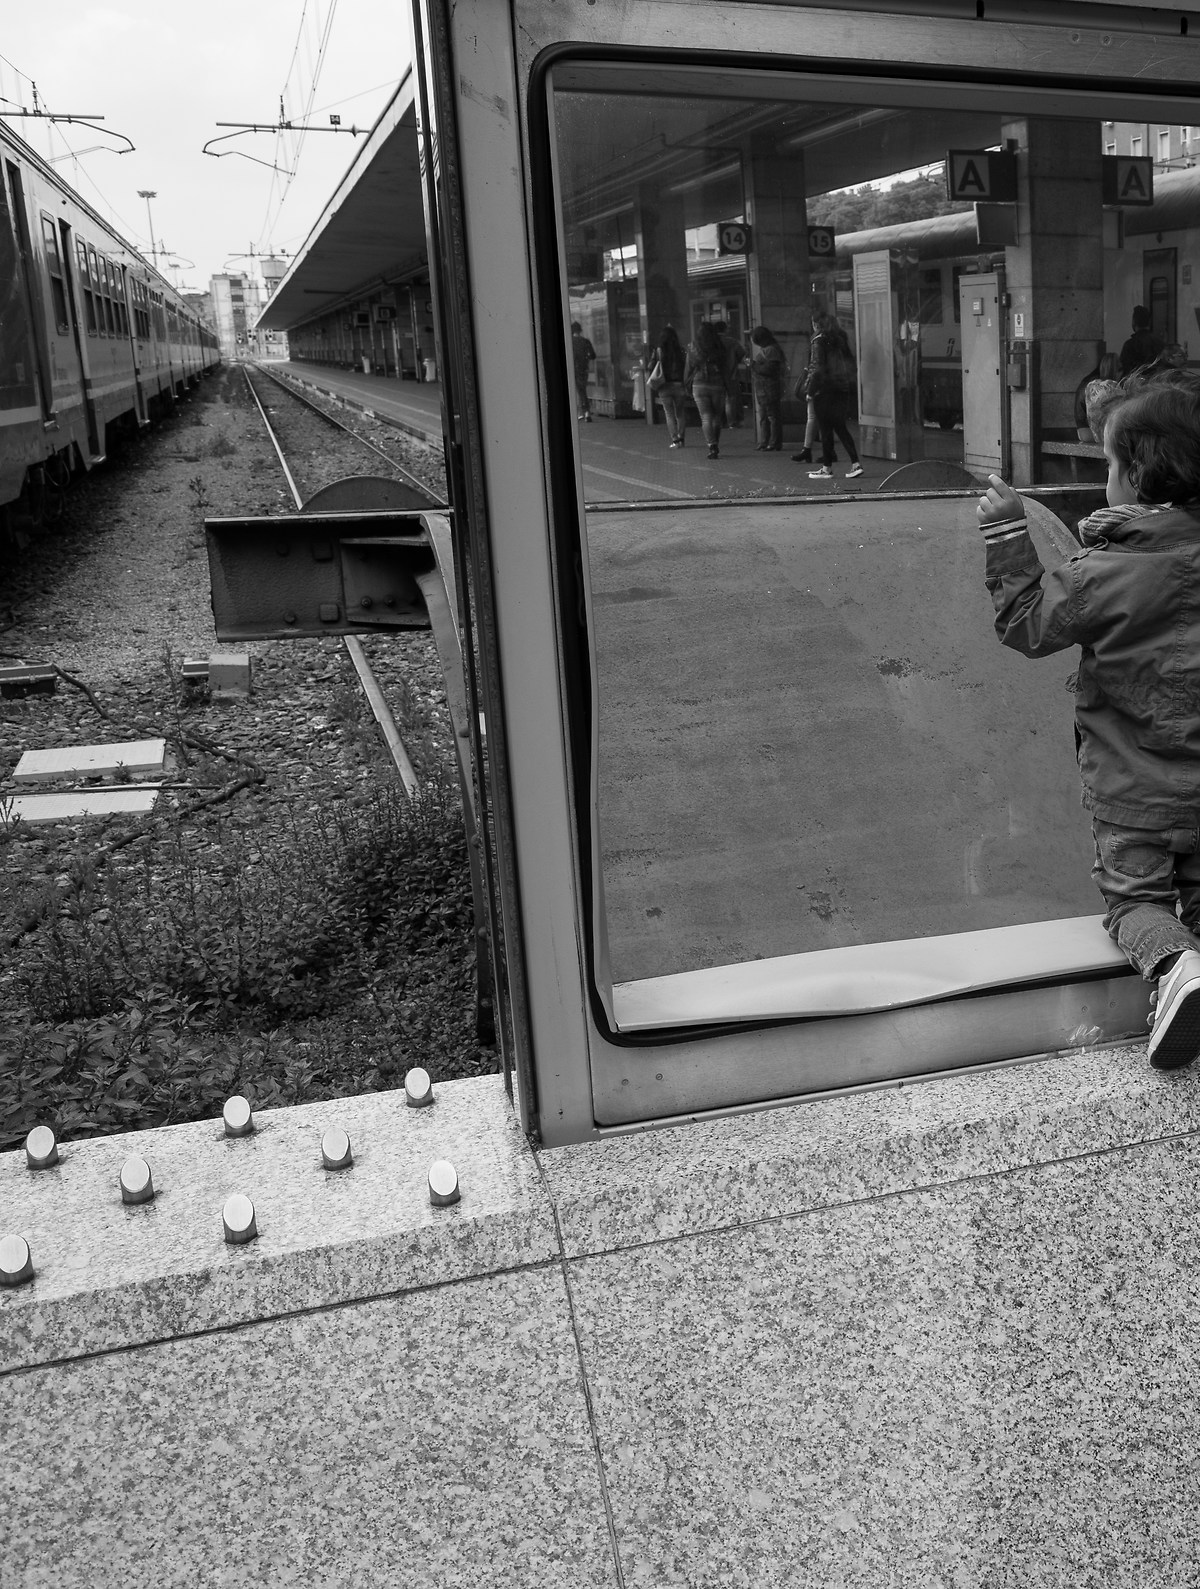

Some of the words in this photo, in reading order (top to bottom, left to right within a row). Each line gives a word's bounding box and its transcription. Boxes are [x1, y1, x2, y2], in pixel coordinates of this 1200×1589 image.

[957, 159, 986, 192] A
[1120, 165, 1147, 197] A
[725, 231, 743, 245] 14
[812, 235, 829, 249] 15
